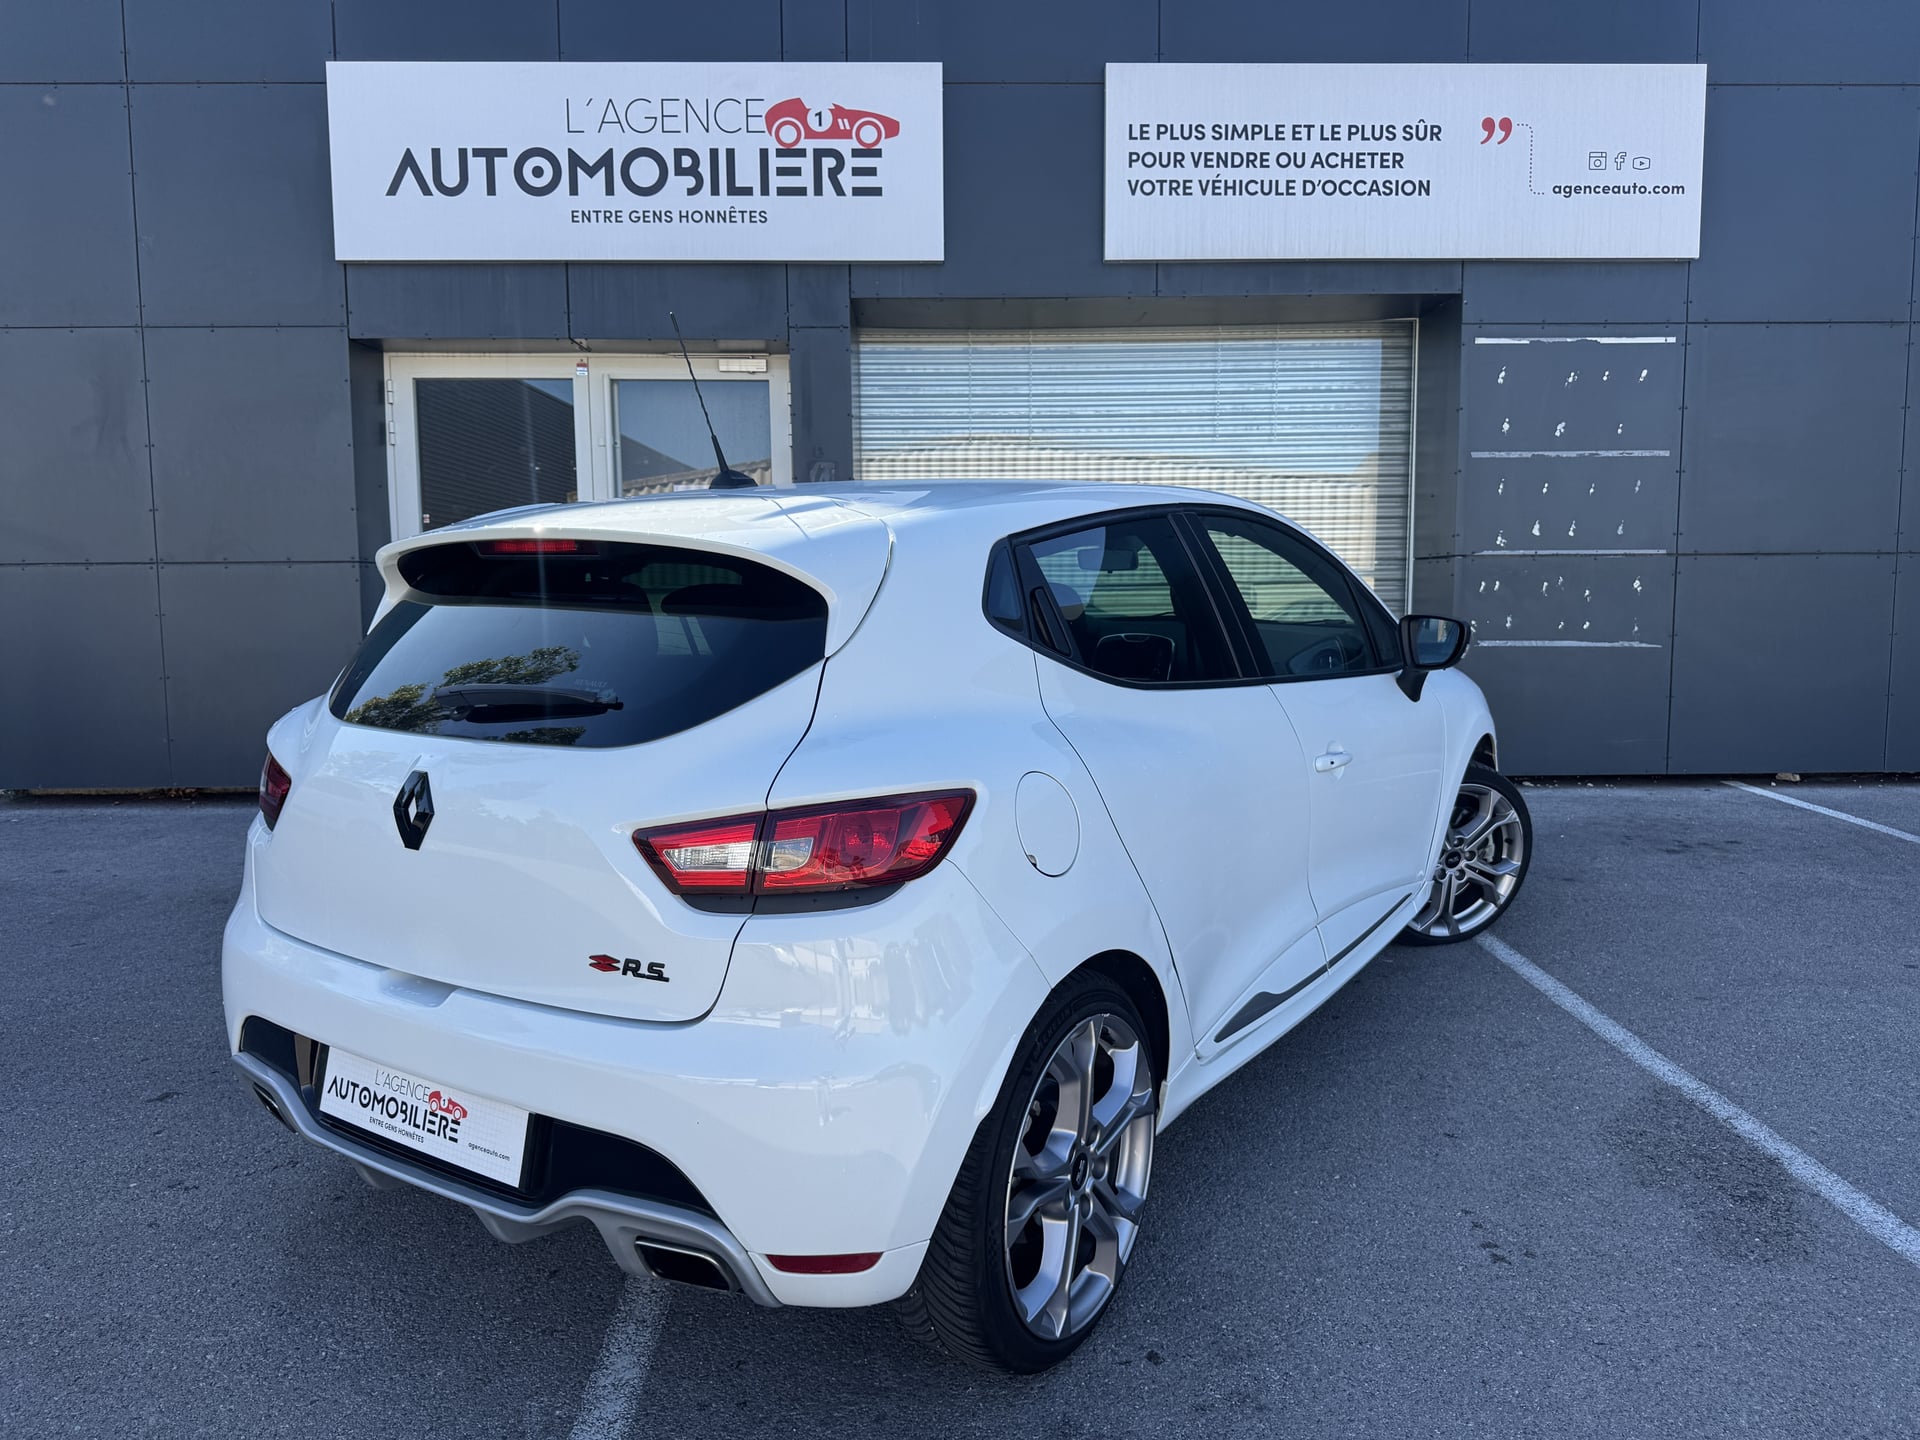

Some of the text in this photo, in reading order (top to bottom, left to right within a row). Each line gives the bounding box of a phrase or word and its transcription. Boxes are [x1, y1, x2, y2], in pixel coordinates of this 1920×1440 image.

[565, 97, 765, 134] L'AGENCE
[811, 110, 823, 127] 1
[1128, 118, 1442, 142] LE PLUS SIMPLE ET LE PLUS SÛR
[1128, 151, 1405, 169] POUR VENDRE OU ACHETER
[1127, 173, 1431, 197] VOTRE VÉHICULE D'OCCASION
[1552, 182, 1685, 199] agenceauto.com
[570, 205, 768, 224] ENTRE GENS HONNÊTES
[374, 1069, 429, 1103] L'AGENCE
[369, 1116, 384, 1128] ENTRE
[384, 1122, 398, 1133] GENS
[468, 1142, 510, 1161] agenceauto.com
